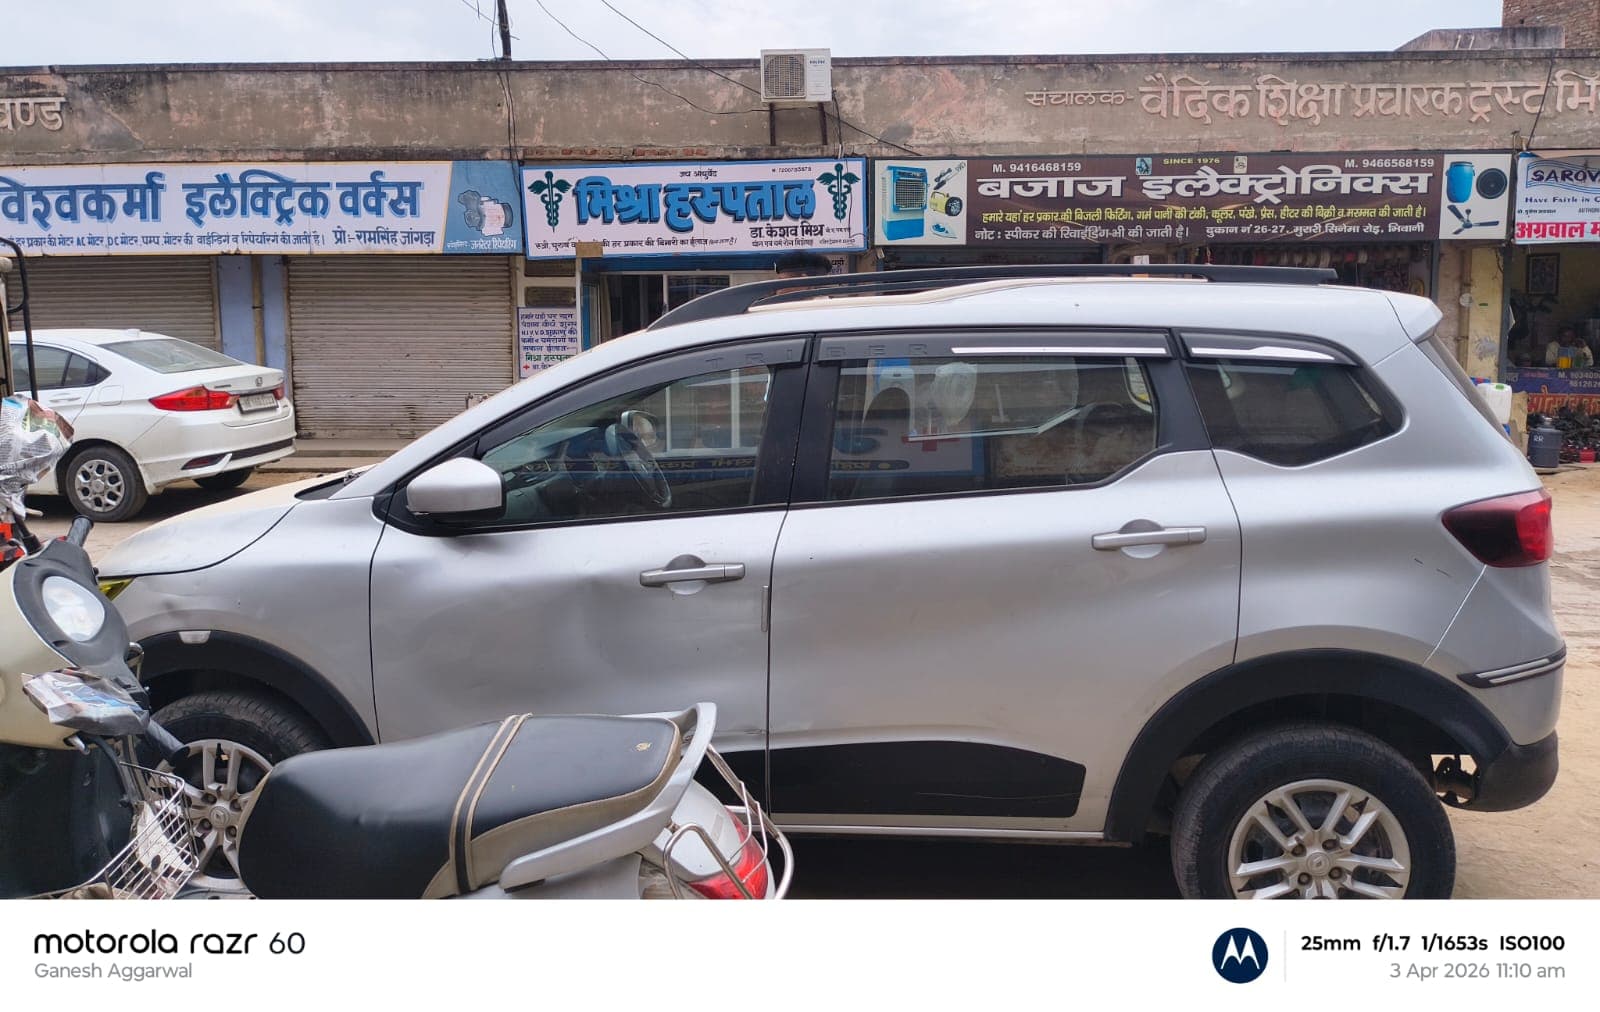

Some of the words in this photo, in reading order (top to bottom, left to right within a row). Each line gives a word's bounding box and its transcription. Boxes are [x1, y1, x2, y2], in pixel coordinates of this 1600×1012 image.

[1138, 72, 1252, 125] वैदिक
[1255, 74, 1348, 127] शिक्षा
[992, 163, 1006, 173] M.
[1009, 161, 1081, 173] 9416468159
[1163, 157, 1194, 165] SINCE
[1197, 157, 1221, 165] 1976
[1344, 159, 1359, 169] M.
[1362, 158, 1435, 168] 9466568159
[1531, 169, 1600, 183] SAROV
[976, 175, 1127, 199] बजाज
[182, 169, 333, 228] इलैक्ट्रिक
[572, 175, 662, 226] मिश्रा
[663, 179, 816, 233] हस्पताल
[982, 210, 1003, 223] हमारे
[1023, 212, 1034, 222] हर
[1036, 211, 1059, 222] प्रकार
[1060, 208, 1073, 221] की
[1074, 208, 1102, 221] बिजली
[1136, 207, 1152, 220] गर्म
[1154, 206, 1172, 220] पानी
[1174, 206, 1187, 219] की
[1279, 205, 1300, 219] हीटर
[1301, 204, 1313, 218] की
[1315, 204, 1336, 220] बिक्री
[1346, 207, 1376, 218] मरम्मत
[1378, 204, 1390, 217] की
[1392, 203, 1413, 217] जाती
[355, 226, 399, 246] रामसिंह
[399, 227, 436, 248] जांगड़ा
[765, 223, 798, 239] केशव
[799, 220, 825, 237] मिश्र
[974, 227, 995, 240] नोट
[1004, 226, 1040, 240] स्पीकर
[1042, 226, 1057, 239] की
[1127, 225, 1143, 239] की
[1145, 225, 1173, 238] जाती
[1204, 226, 1238, 238] दुकान
[1293, 222, 1322, 237] मुरारी
[1325, 222, 1360, 234] सिनेमा
[1388, 222, 1425, 233] भिवानी
[1516, 222, 1587, 239] अग्रवाल
[27, 236, 46, 248] प्रकार
[47, 234, 57, 247] की
[58, 233, 74, 247] मोटर
[76, 236, 86, 246] AC
[107, 236, 119, 246] DC
[163, 232, 182, 246] मोटर
[183, 232, 194, 246] की
[231, 234, 239, 245] व
[279, 231, 291, 245] की
[291, 231, 311, 245] जाती
[623, 239, 644, 249] प्रकार
[645, 237, 655, 247] की
